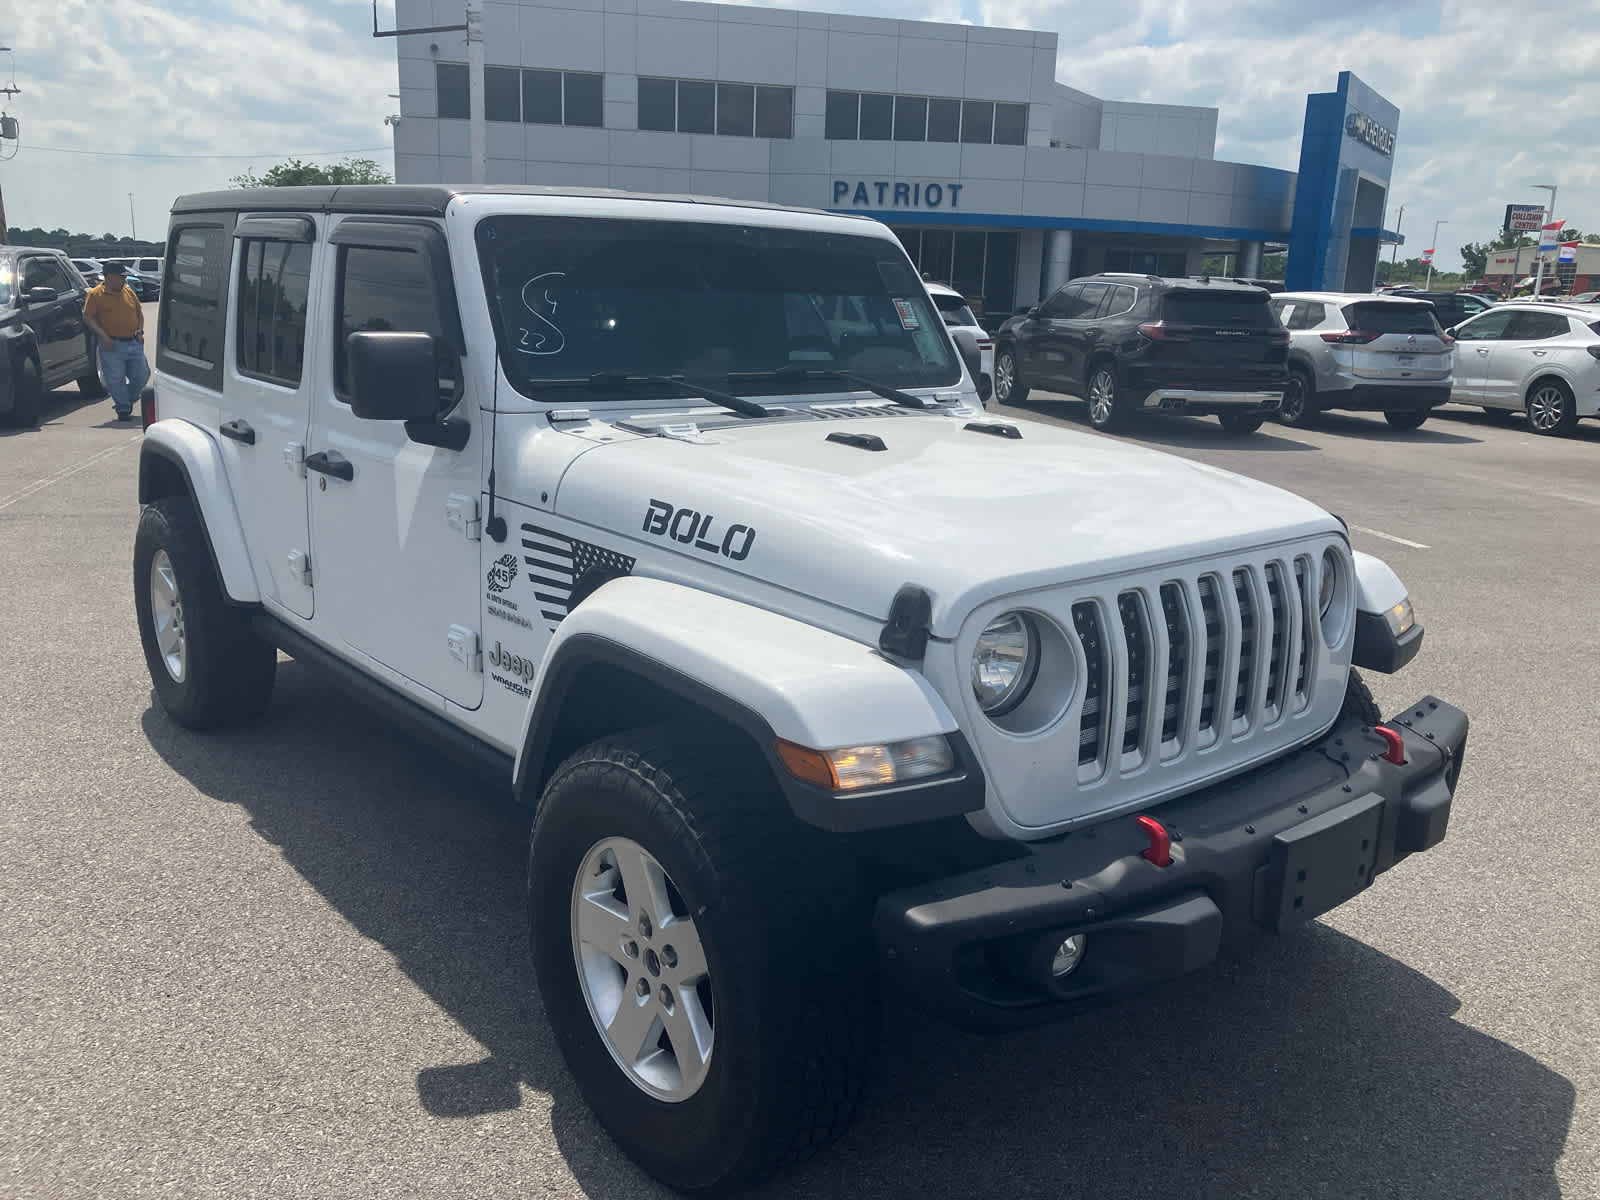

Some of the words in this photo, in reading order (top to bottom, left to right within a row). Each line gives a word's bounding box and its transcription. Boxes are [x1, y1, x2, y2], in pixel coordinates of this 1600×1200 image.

[1366, 118, 1395, 154] CHEVROLET
[833, 181, 963, 207] PATRIOT
[1512, 212, 1543, 221] COLLISION
[1514, 221, 1537, 230] CENTER
[642, 498, 756, 561] BOLO
[495, 568, 508, 582] 45
[489, 640, 534, 685] Jeep
